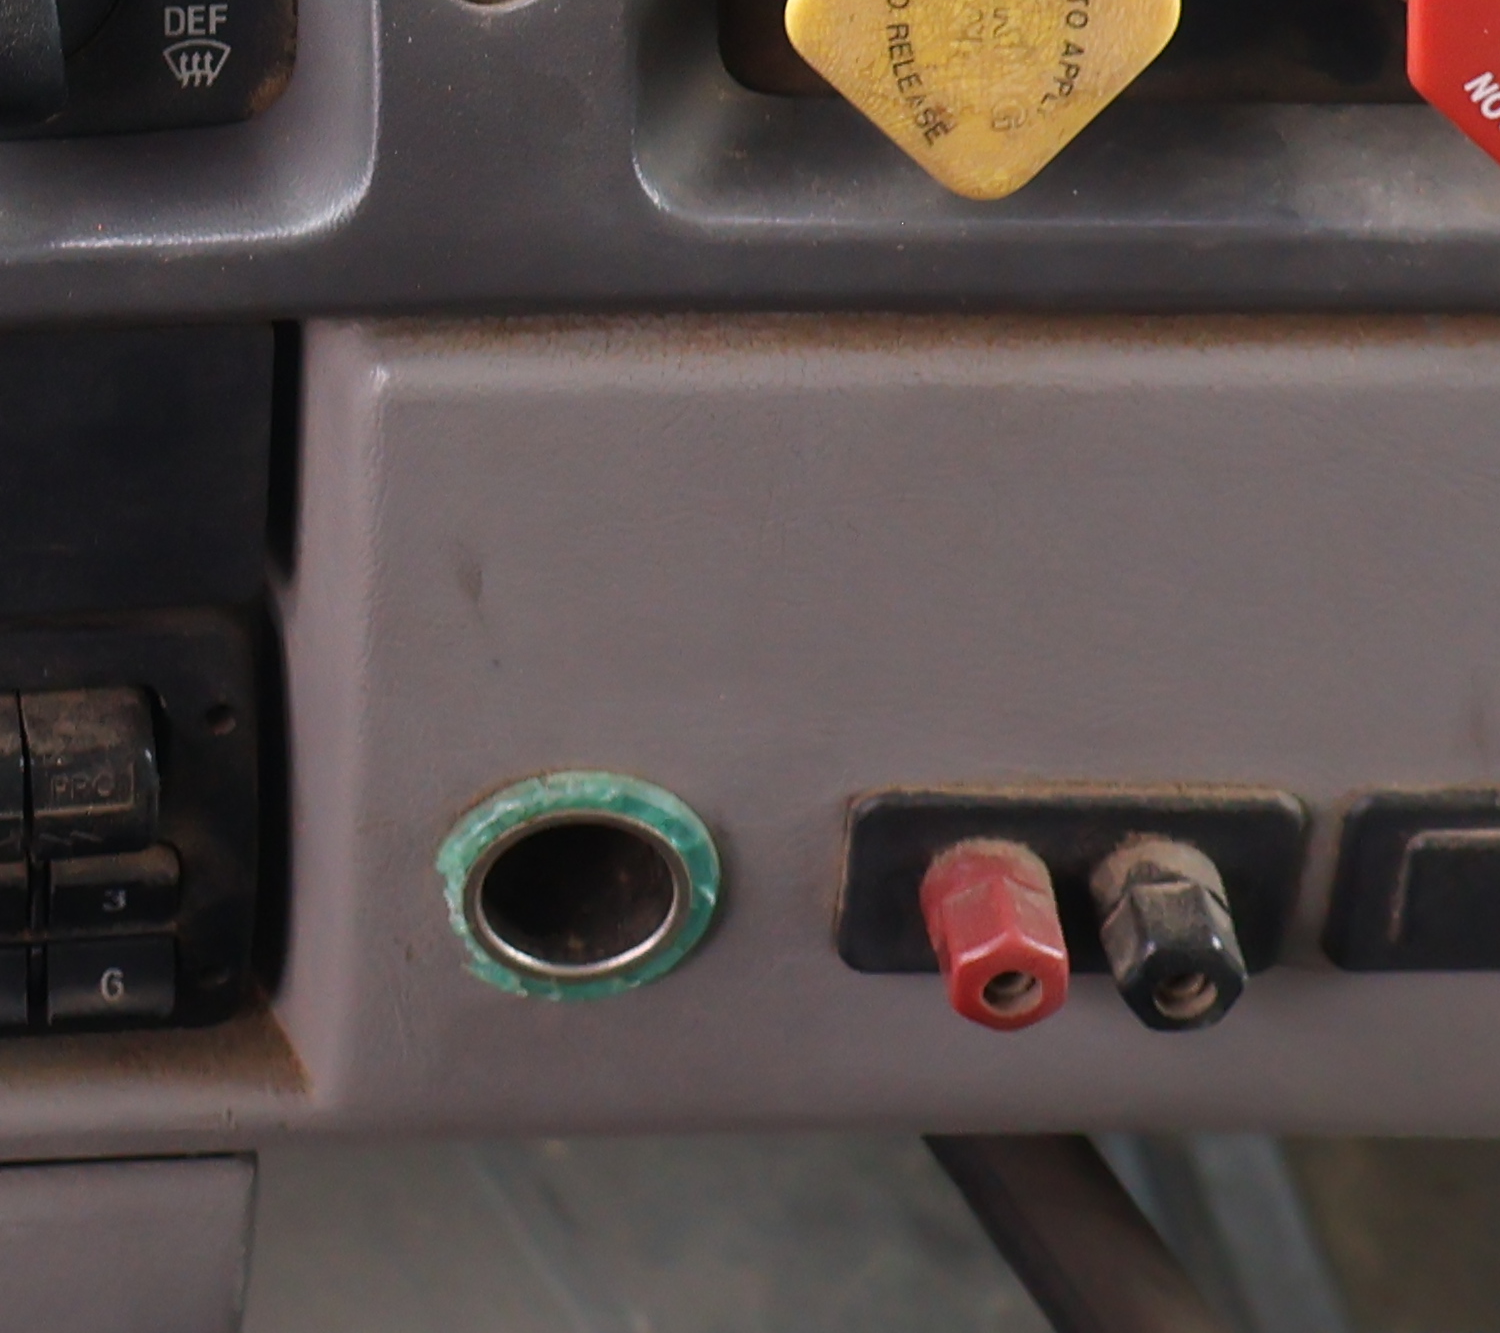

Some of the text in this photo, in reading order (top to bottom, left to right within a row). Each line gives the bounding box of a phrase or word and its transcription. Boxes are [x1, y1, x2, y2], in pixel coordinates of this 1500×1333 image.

[164, 5, 228, 36] DEF
[886, 22, 952, 148] RELEASE
[103, 890, 127, 912] 3
[100, 969, 125, 1004] 6
